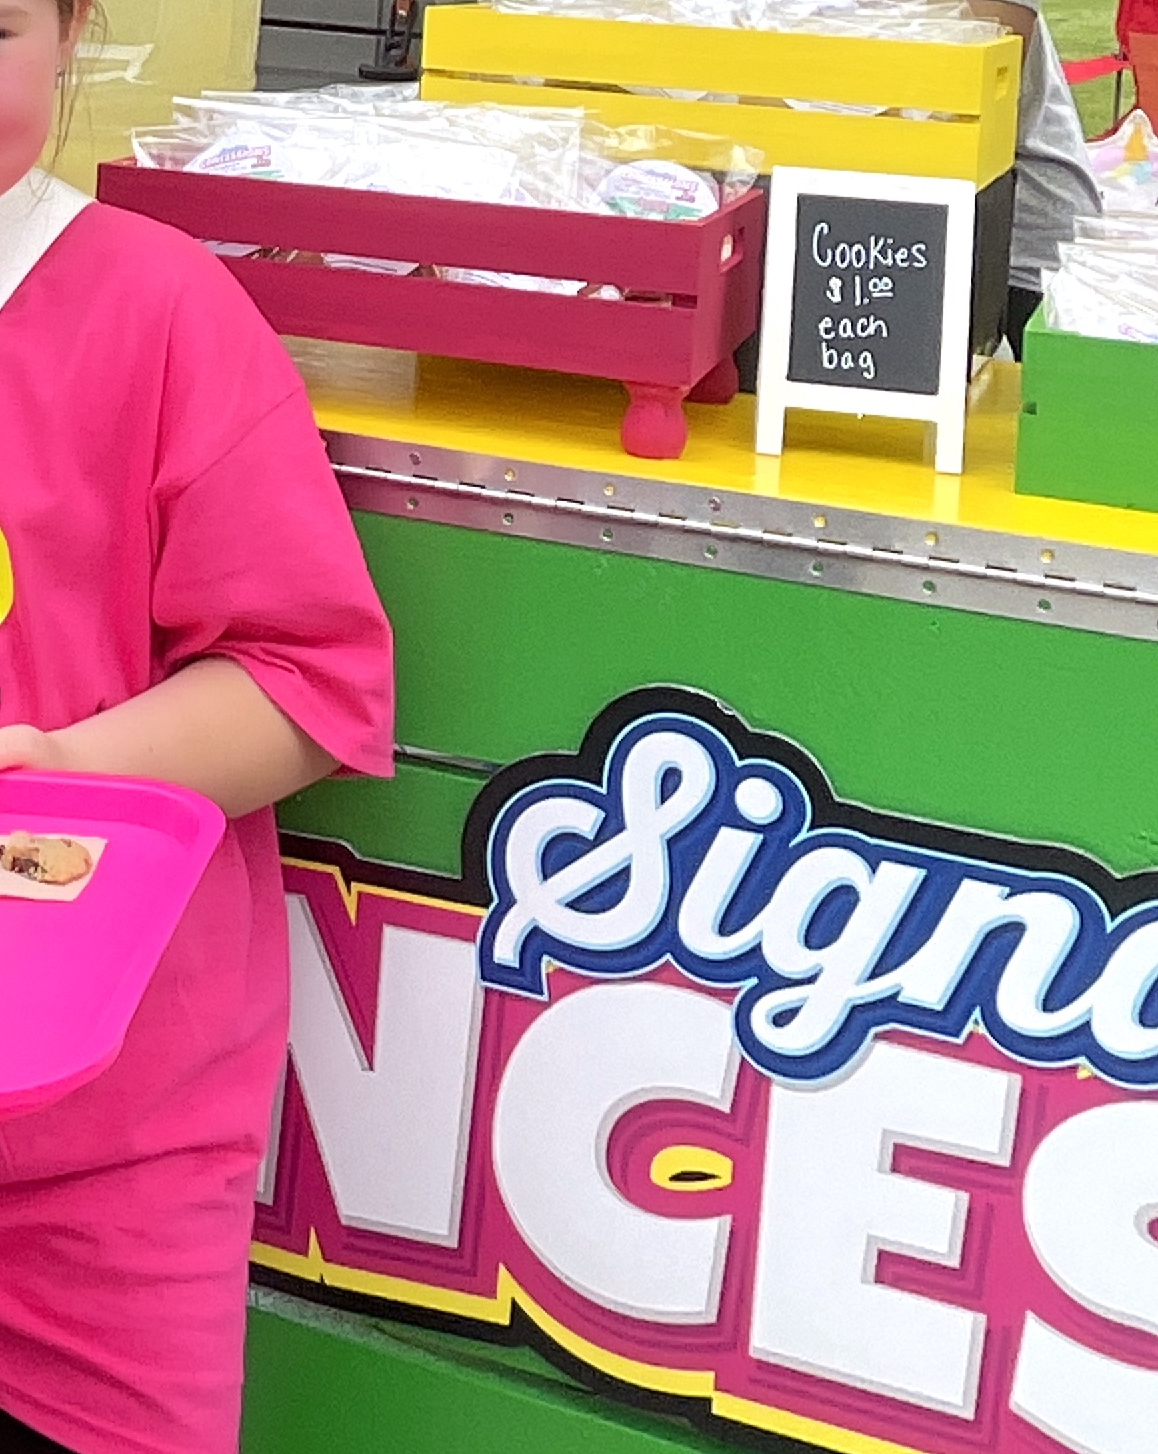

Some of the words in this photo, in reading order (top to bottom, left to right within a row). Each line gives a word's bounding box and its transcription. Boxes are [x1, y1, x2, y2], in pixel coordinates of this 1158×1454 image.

[811, 221, 928, 270] Cookies
[818, 314, 888, 339] each
[821, 342, 876, 380] bag
